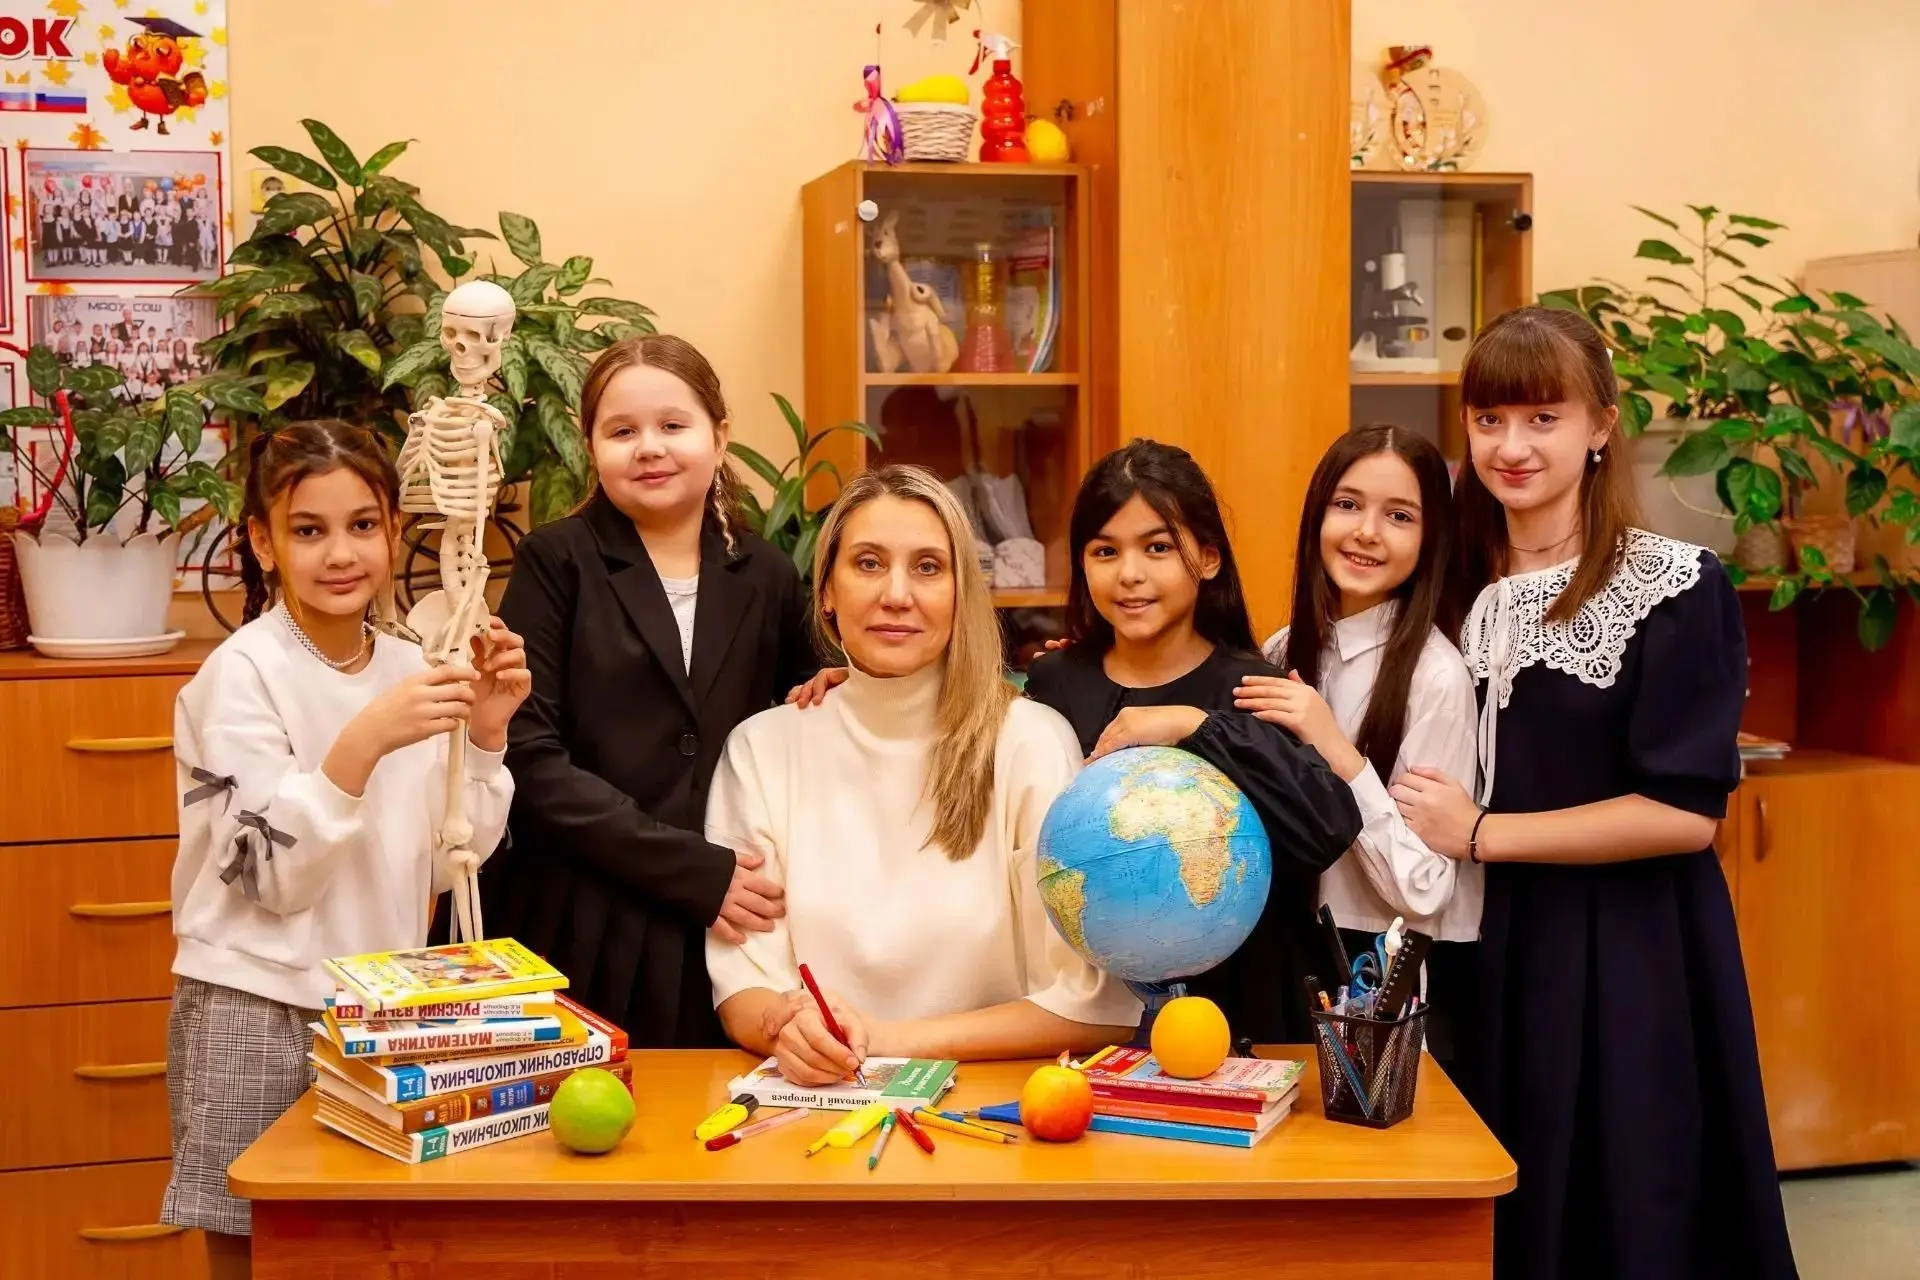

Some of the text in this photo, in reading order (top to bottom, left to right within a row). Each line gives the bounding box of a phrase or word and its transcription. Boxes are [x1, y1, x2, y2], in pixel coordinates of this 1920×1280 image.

[419, 1002, 480, 1020] РУССКИЙ
[388, 1032, 492, 1052] МАТЕМАТИКА
[431, 1045, 603, 1090] СПРАВОЧНИК ШКОЛЬНИКА
[771, 1094, 823, 1107] Григорьев
[453, 1115, 532, 1147] ШКОЛЬНИКА
